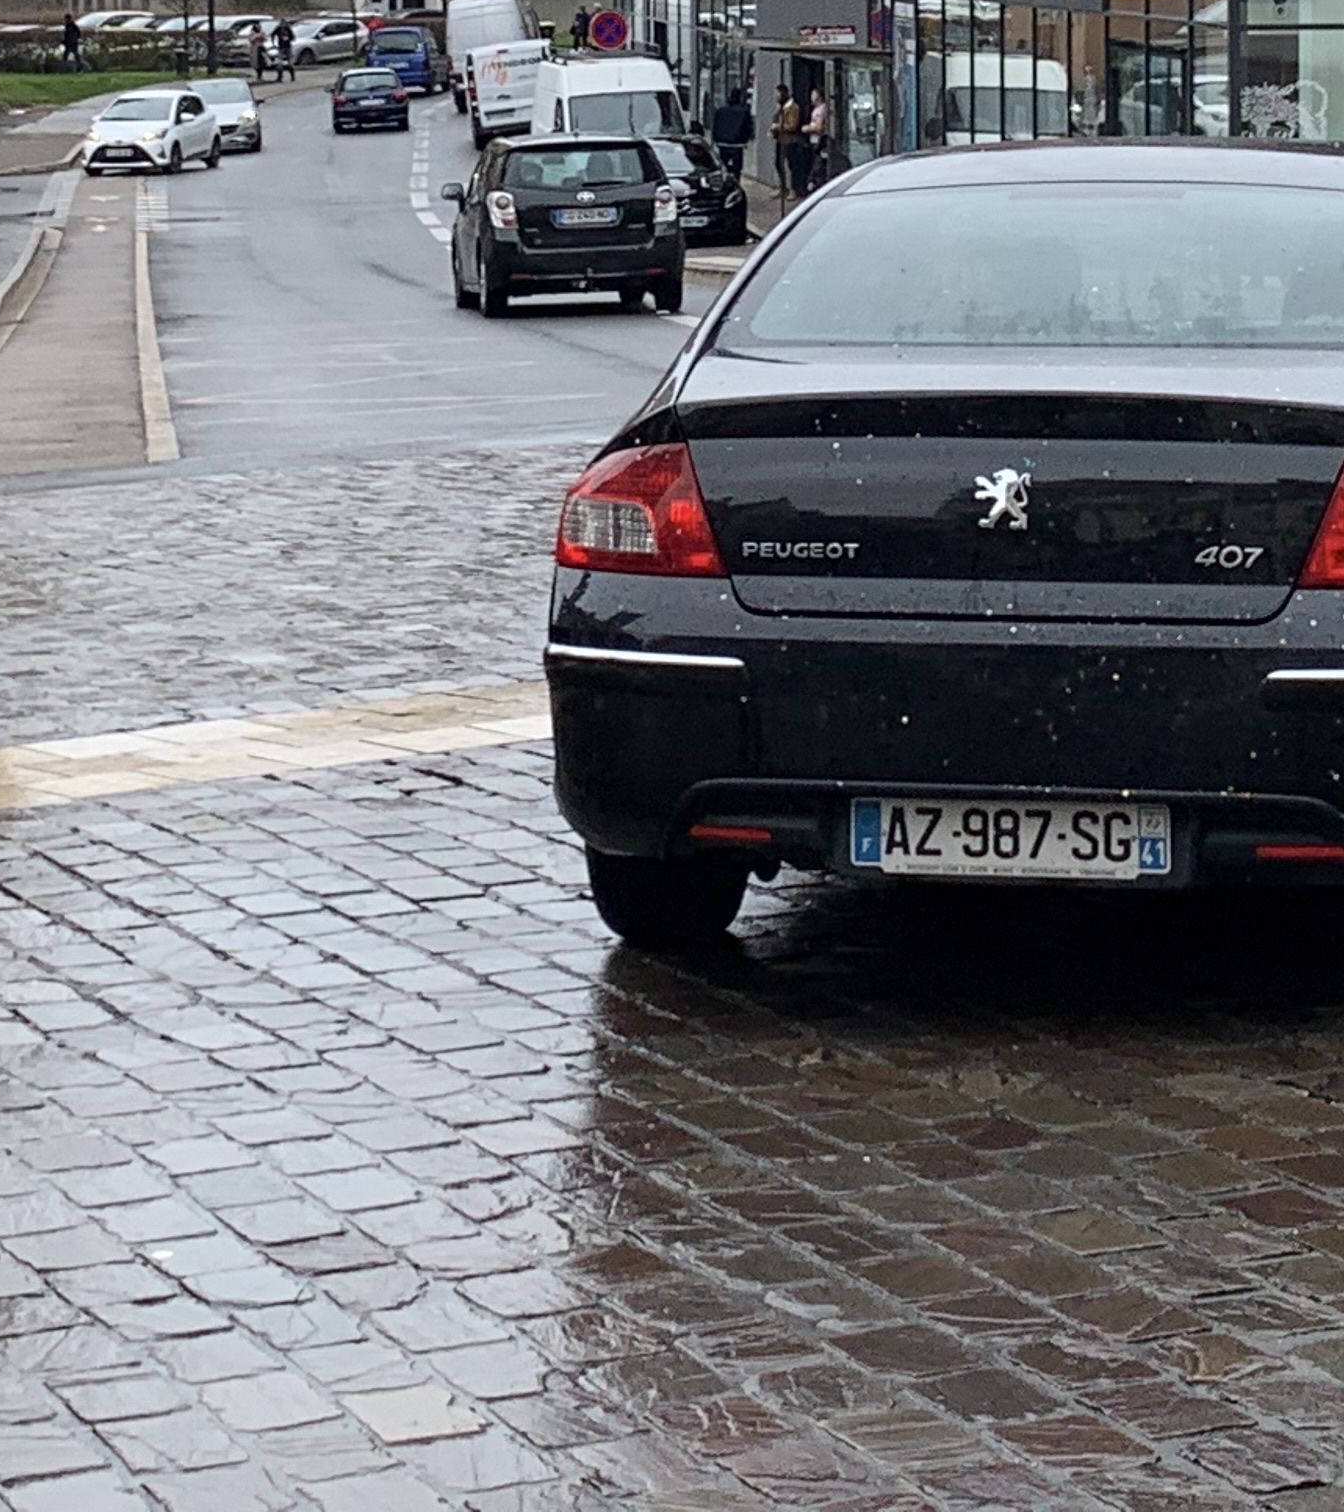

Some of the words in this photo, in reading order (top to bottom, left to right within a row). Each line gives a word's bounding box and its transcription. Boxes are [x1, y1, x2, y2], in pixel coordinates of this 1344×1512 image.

[741, 541, 861, 561] PEUGEOT
[1194, 544, 1265, 571] 407
[860, 837, 873, 854] F
[884, 805, 1133, 864] AZ-987-SG
[1140, 839, 1166, 867] 41
